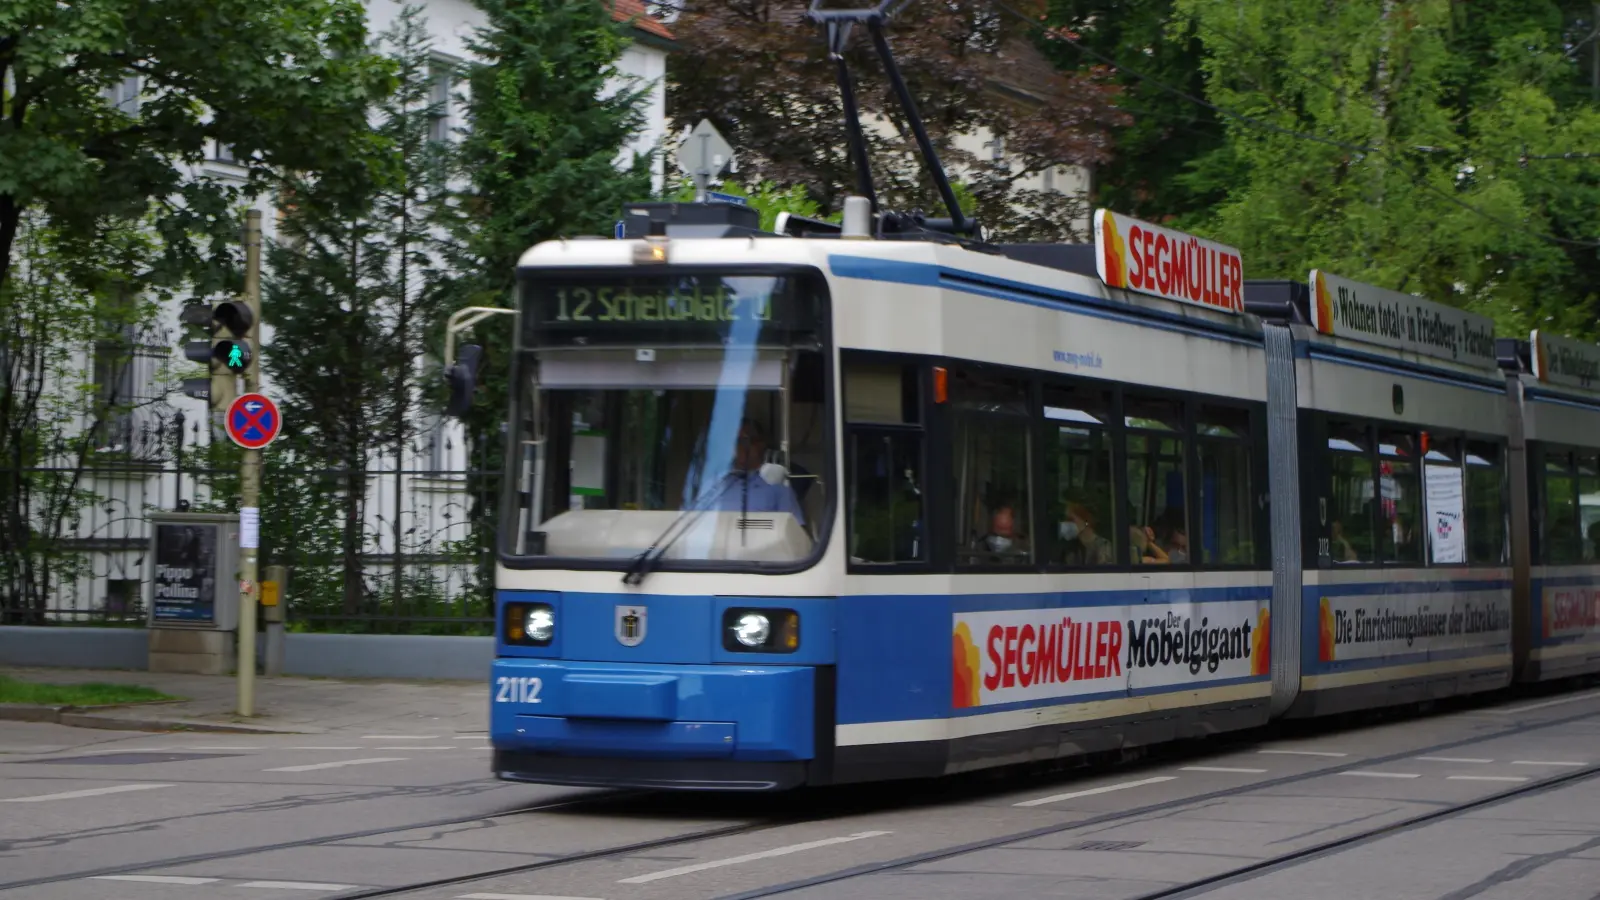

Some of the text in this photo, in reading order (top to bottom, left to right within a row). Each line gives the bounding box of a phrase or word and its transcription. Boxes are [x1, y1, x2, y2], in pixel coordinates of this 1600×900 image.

[1129, 225, 1244, 312] SEGMÜLLER
[556, 287, 593, 321] 12
[1406, 306, 1416, 342] in
[155, 564, 193, 582] Pippo
[155, 583, 200, 598] Pollina
[1167, 611, 1181, 629] Der
[1334, 609, 1352, 645] Die
[1354, 606, 1447, 648] Einrichtungshäuser
[1449, 605, 1463, 635] der
[984, 617, 1252, 692] SEGMÜLLER Möbelgigant
[495, 676, 543, 703] 2112
